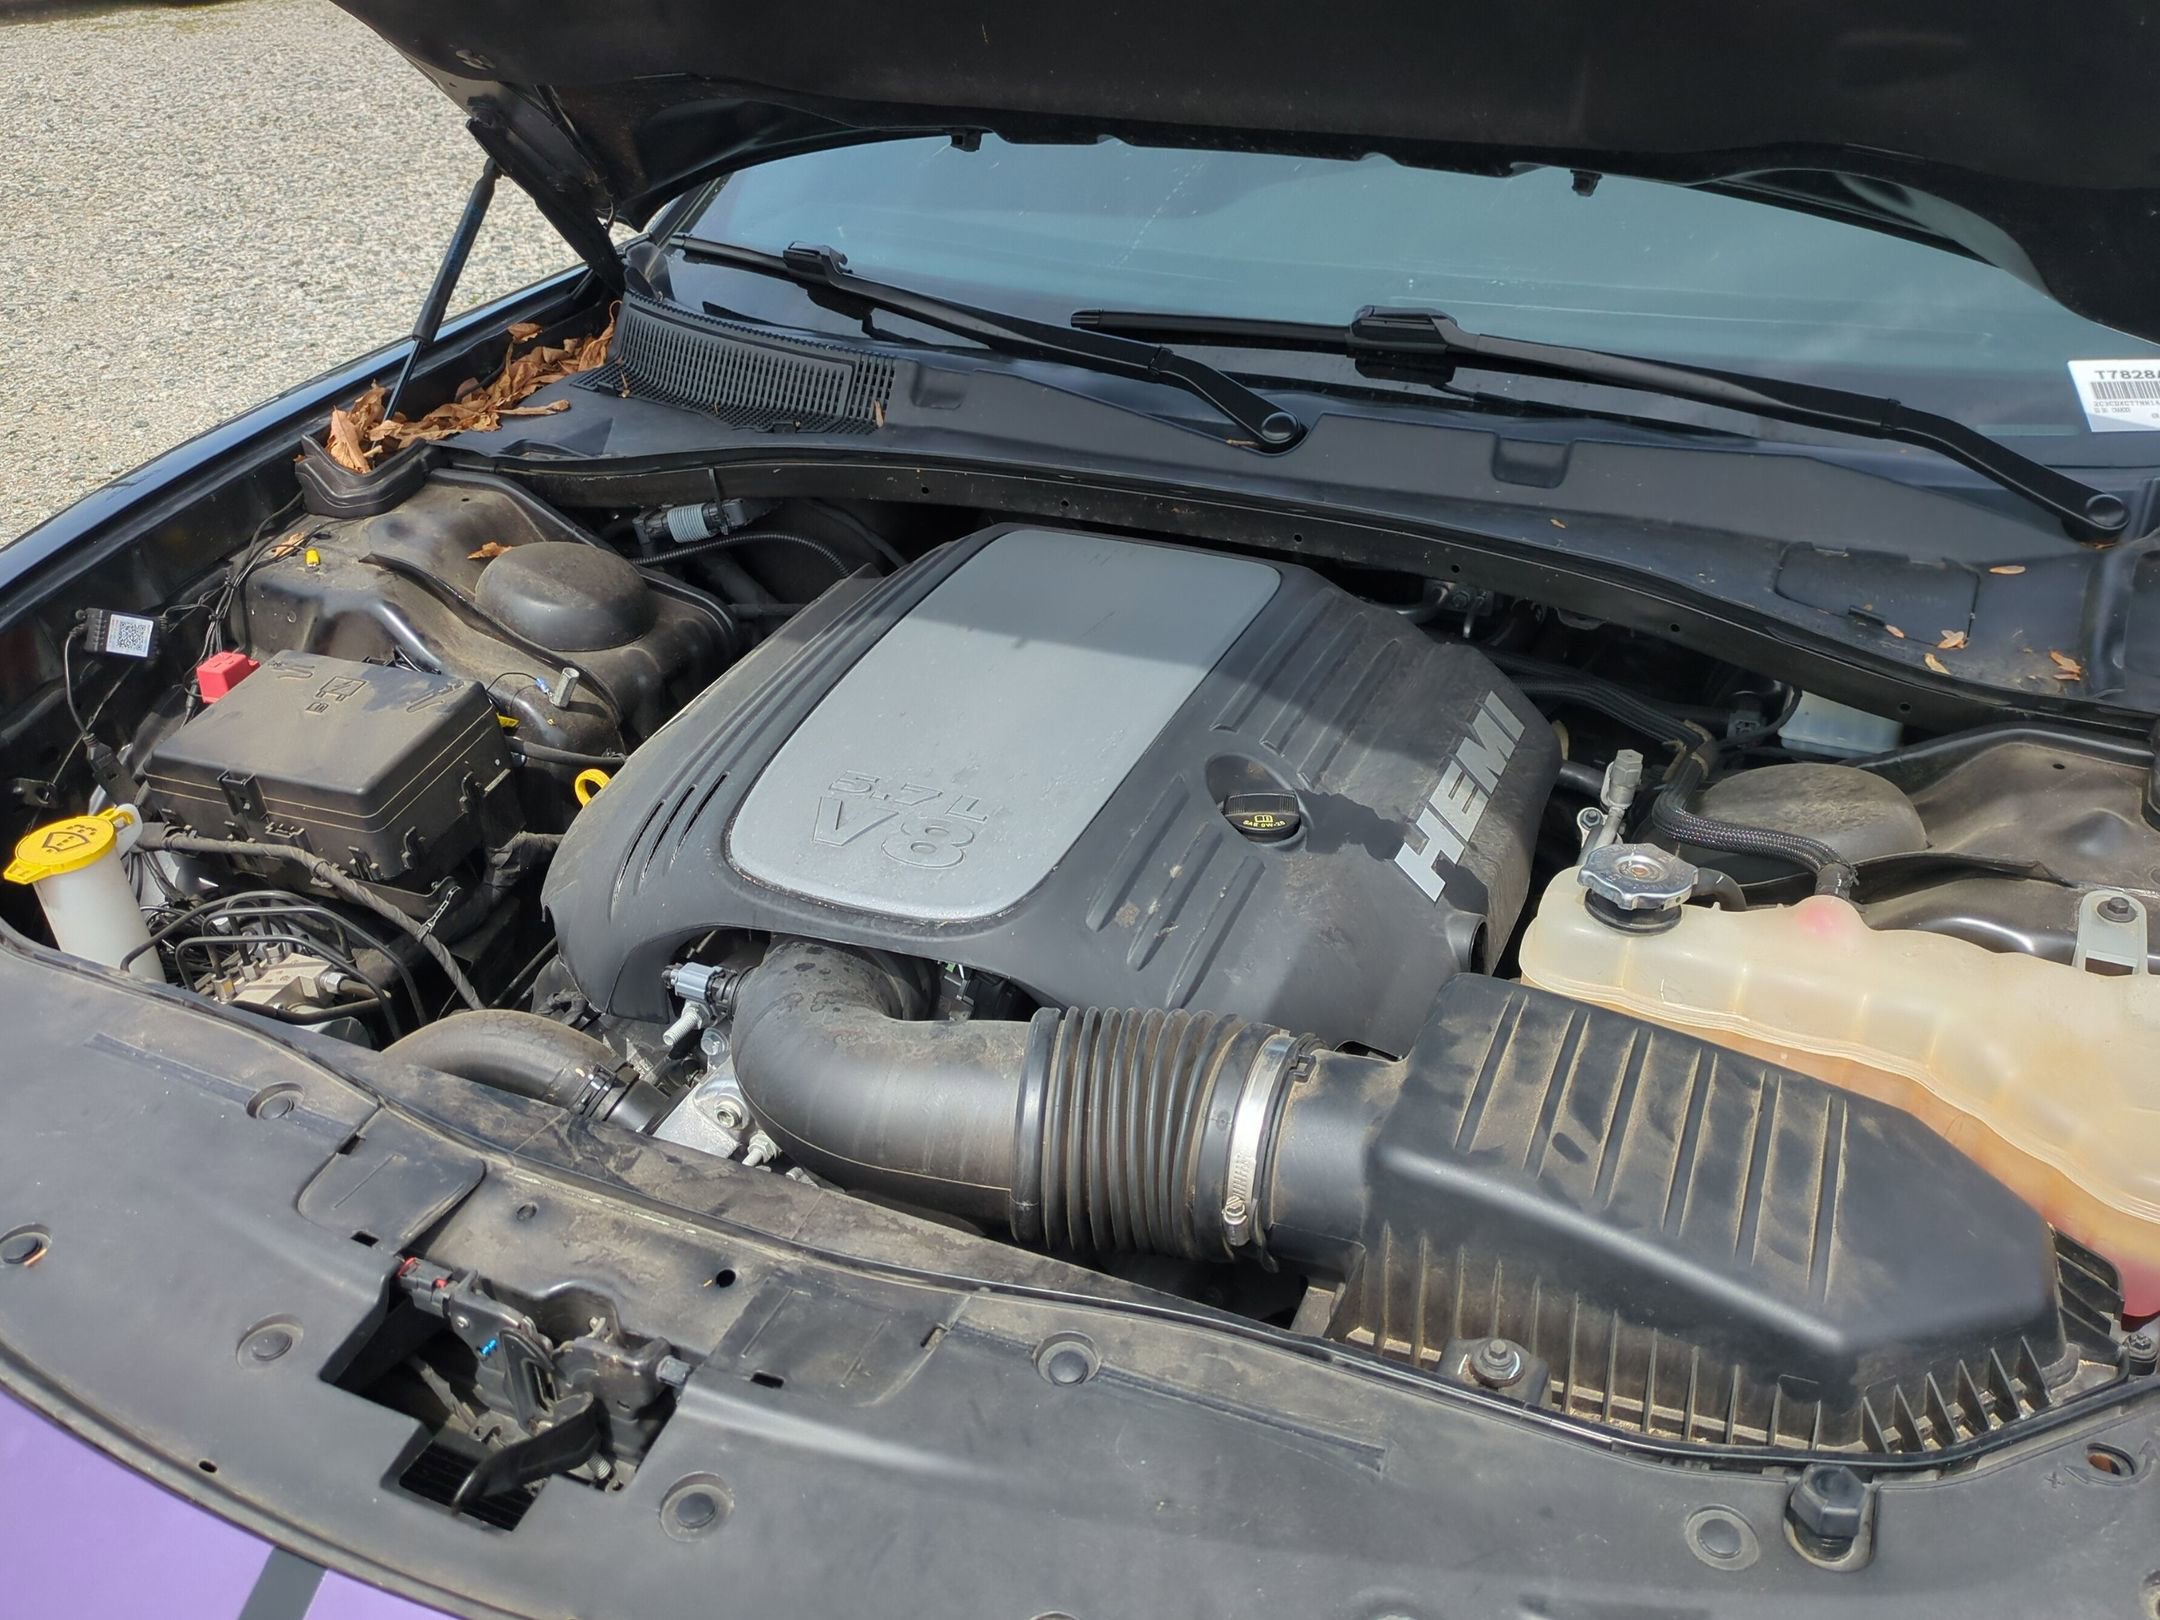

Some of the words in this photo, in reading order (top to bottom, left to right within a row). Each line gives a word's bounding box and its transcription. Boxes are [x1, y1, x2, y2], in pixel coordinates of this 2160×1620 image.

[2094, 370, 2160, 379] T7828
[829, 769, 988, 823] 5.7L
[1394, 690, 1525, 902] HEMI
[812, 795, 975, 869] V8
